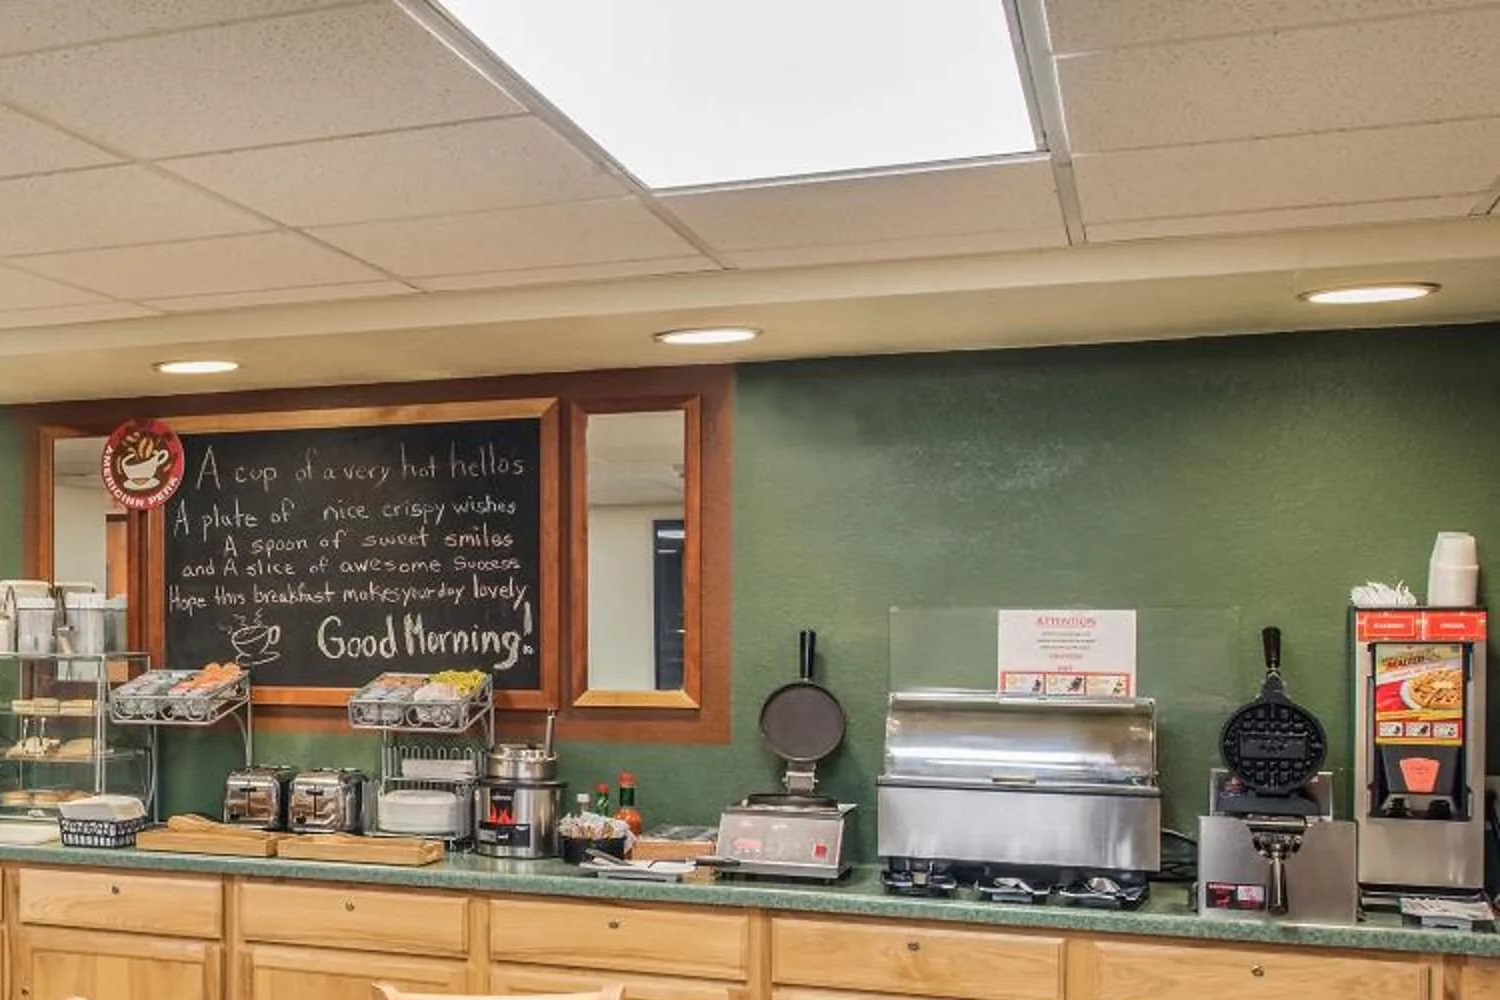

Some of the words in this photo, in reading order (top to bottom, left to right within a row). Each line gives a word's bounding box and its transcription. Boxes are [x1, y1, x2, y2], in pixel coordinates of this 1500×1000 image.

[196, 445, 221, 490] A
[235, 466, 277, 493] cup
[295, 448, 317, 481] of
[401, 441, 436, 479] hot
[174, 499, 189, 536] A
[202, 499, 258, 542] plate
[271, 498, 295, 523] of
[323, 499, 369, 521] nice
[382, 500, 445, 526] crispy
[453, 494, 516, 516] wishes
[224, 534, 238, 557] A
[251, 538, 309, 557] spoon
[319, 529, 347, 549] of
[362, 525, 429, 548] sweet
[444, 522, 514, 548] smiles
[182, 558, 215, 577] and
[223, 557, 238, 577] A
[246, 559, 296, 577] slice
[309, 556, 328, 575] of
[339, 557, 442, 573] awesome
[169, 584, 207, 616] Hope
[214, 584, 245, 605] this
[252, 582, 336, 605] breakfast
[472, 573, 527, 611] lovely
[316, 615, 398, 659] Good
